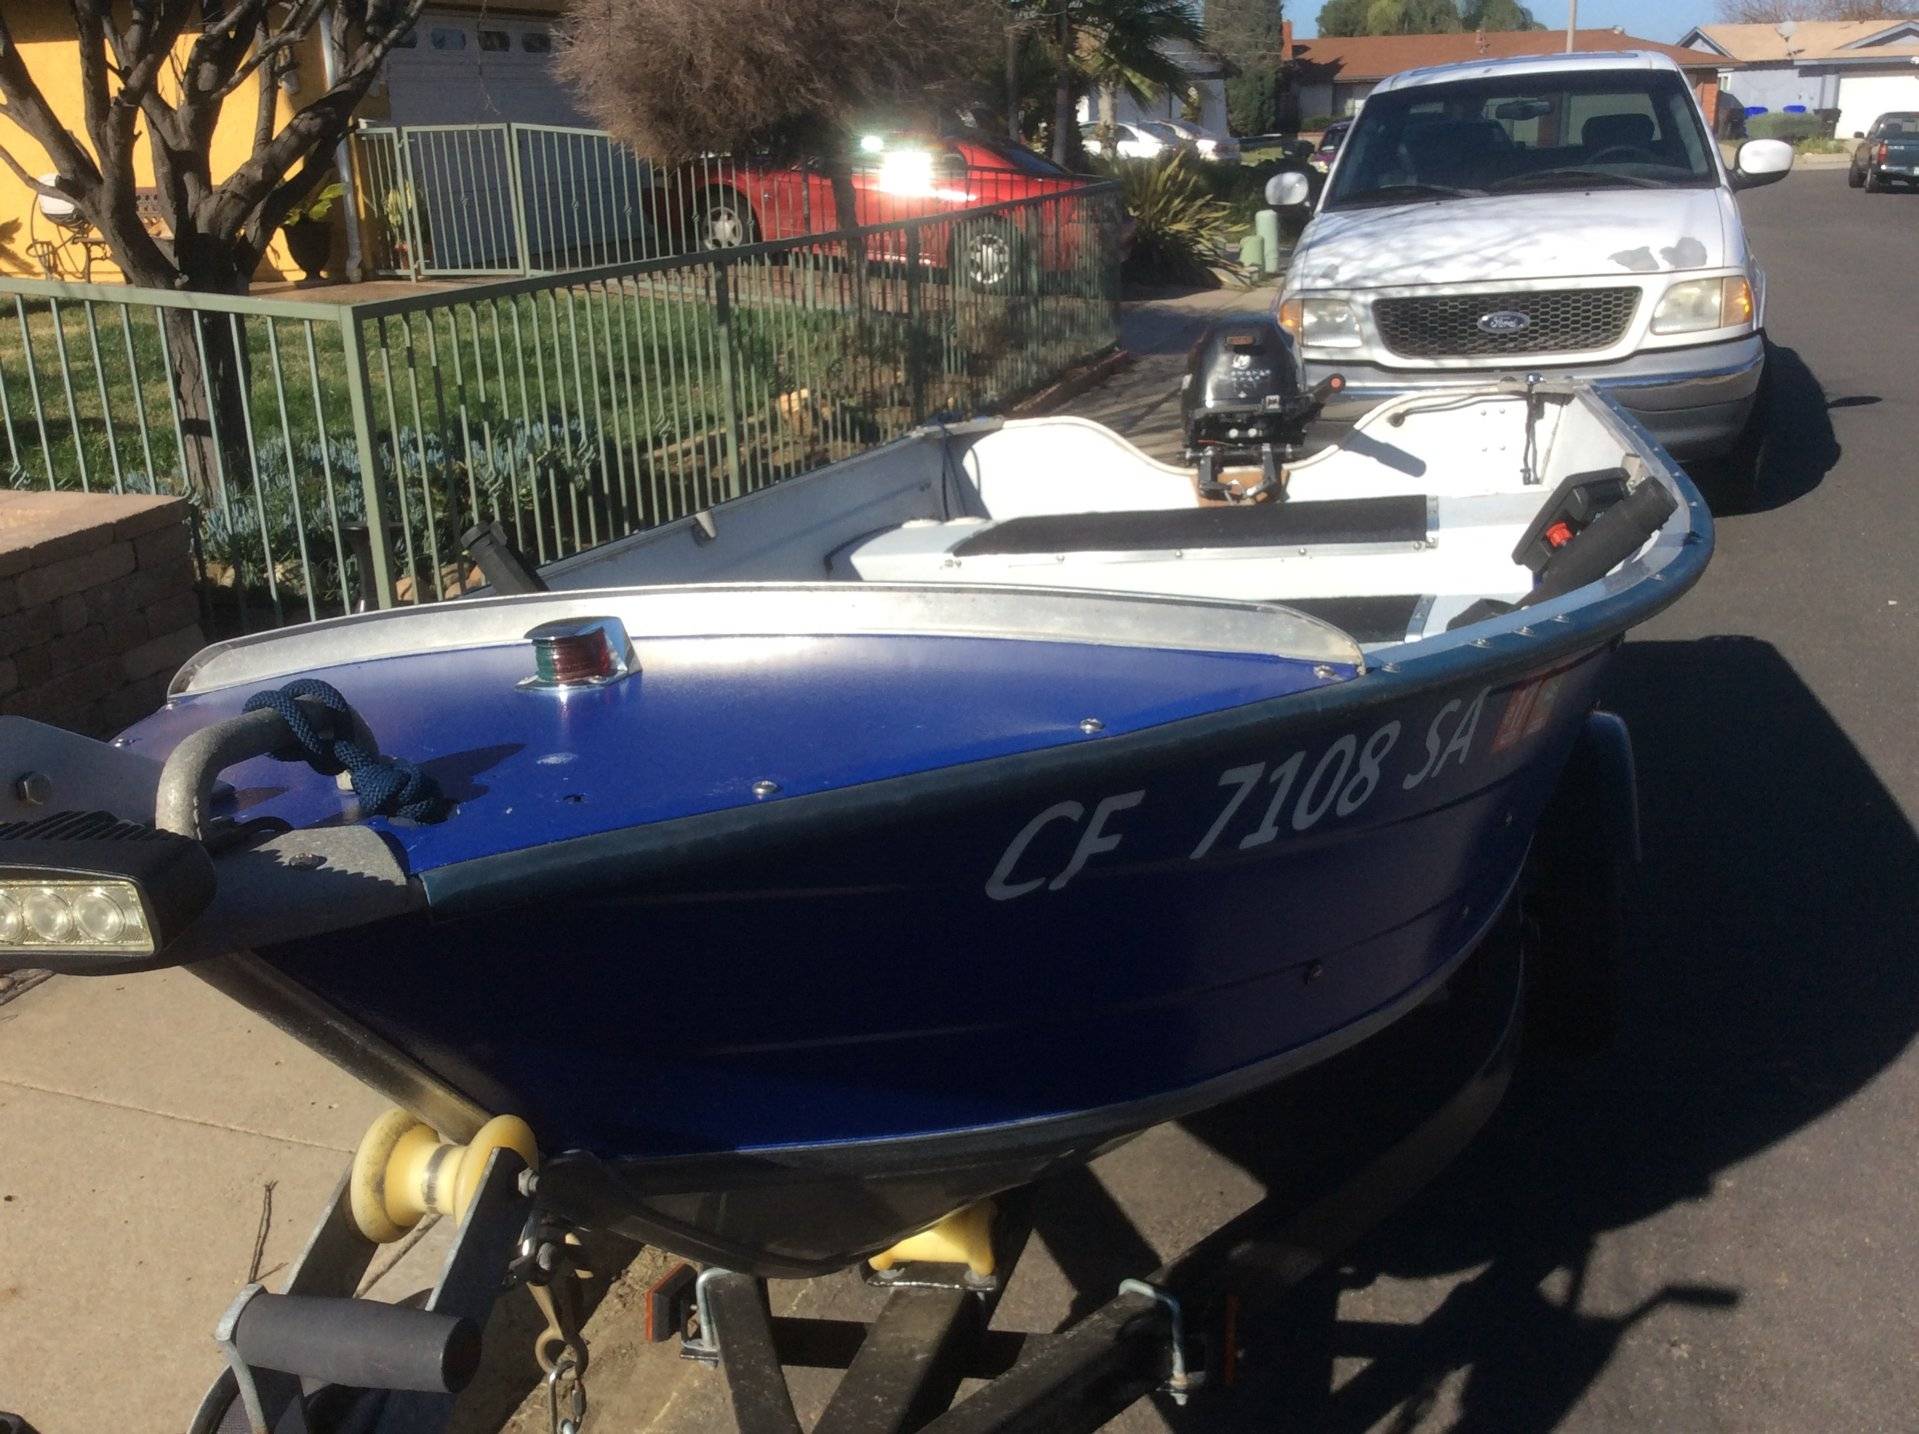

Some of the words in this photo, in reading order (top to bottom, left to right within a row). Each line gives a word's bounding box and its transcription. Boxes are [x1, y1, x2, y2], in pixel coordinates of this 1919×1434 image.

[985, 789, 1146, 901] CF
[1190, 720, 1401, 860] 7108
[1403, 686, 1493, 790] SA
